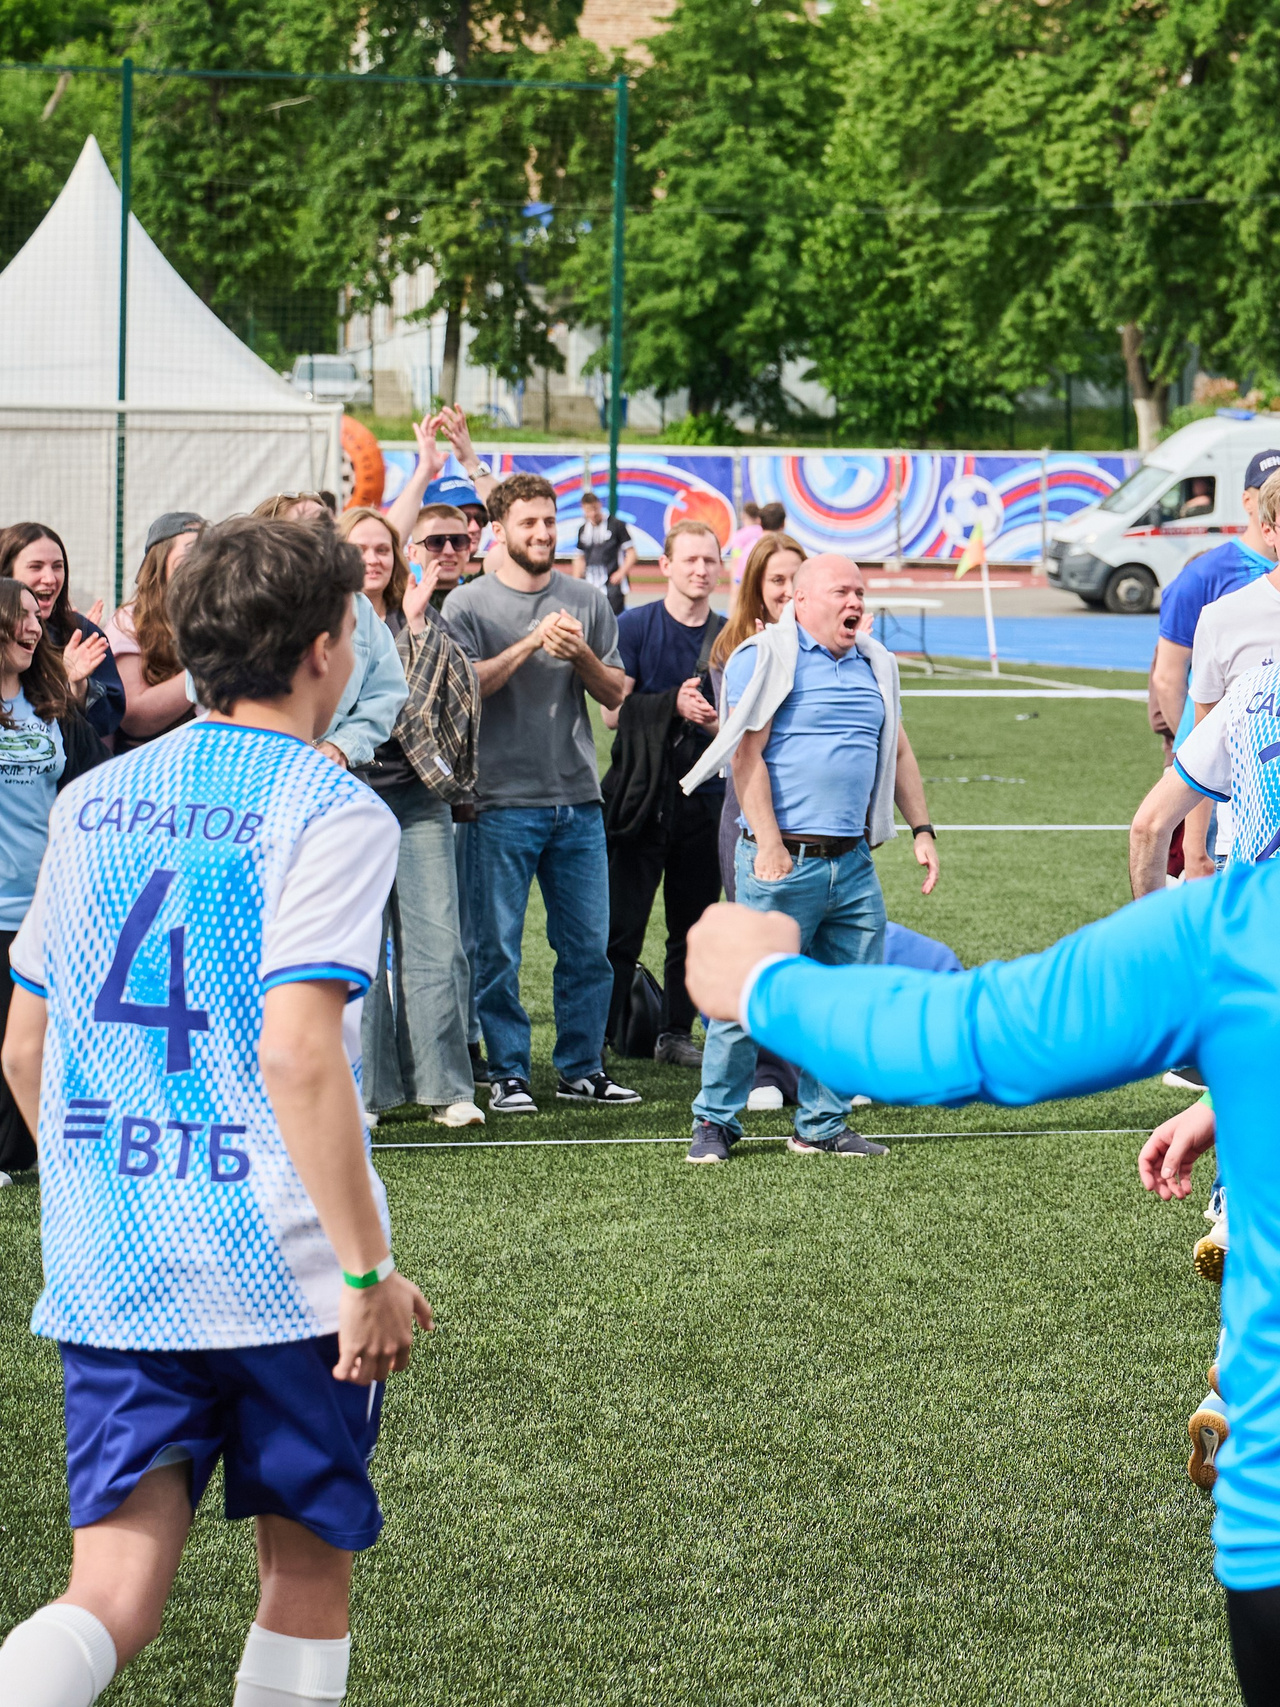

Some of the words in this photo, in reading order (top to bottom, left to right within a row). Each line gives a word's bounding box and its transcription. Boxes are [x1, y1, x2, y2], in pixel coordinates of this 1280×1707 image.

[77, 796, 265, 845] САРАТОВ
[94, 868, 210, 1075] 4
[117, 1116, 251, 1183] ВТБ
